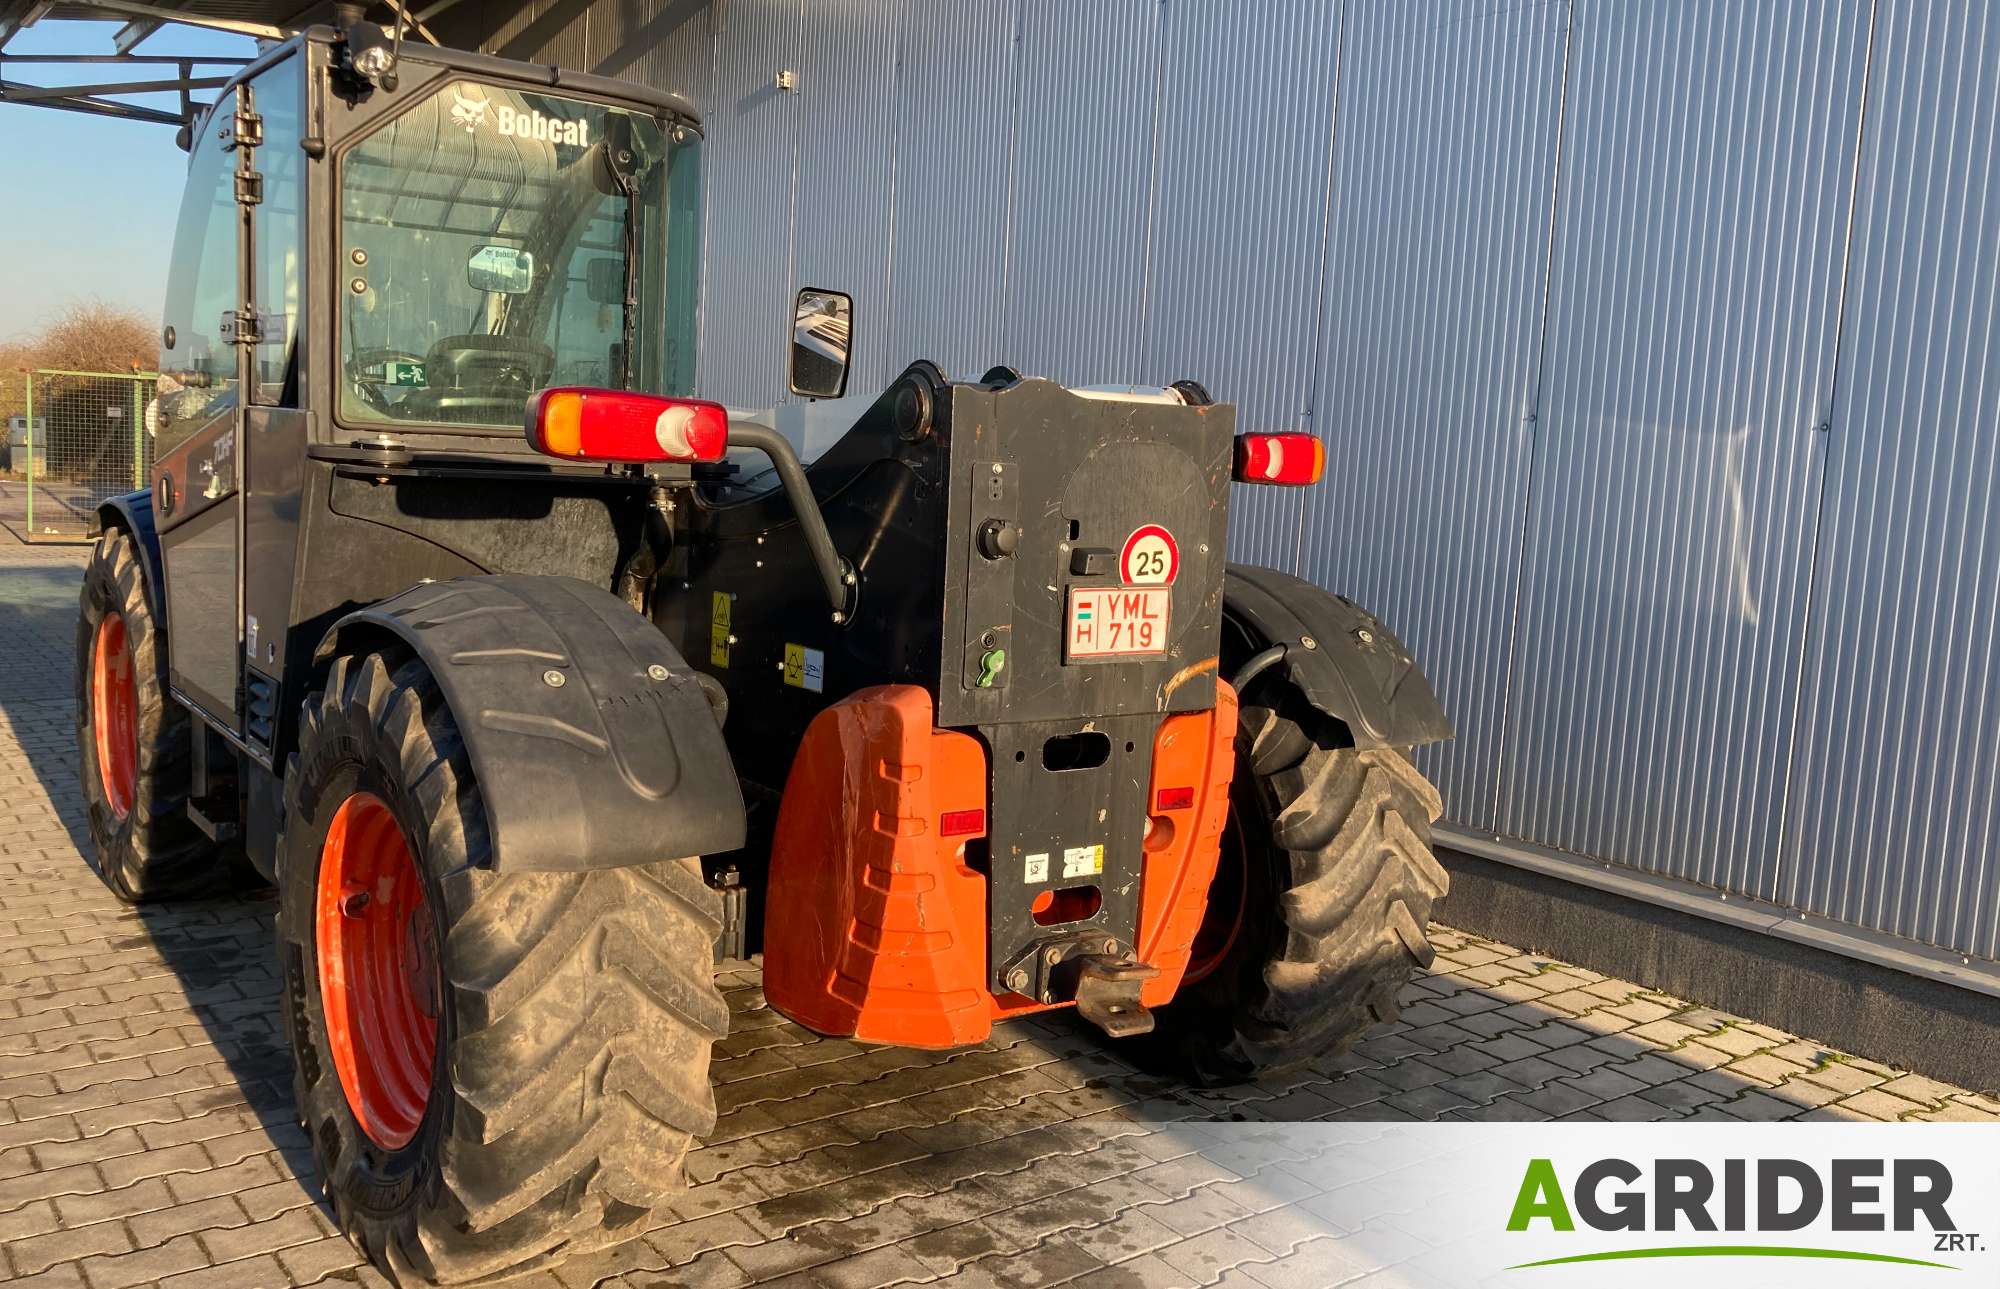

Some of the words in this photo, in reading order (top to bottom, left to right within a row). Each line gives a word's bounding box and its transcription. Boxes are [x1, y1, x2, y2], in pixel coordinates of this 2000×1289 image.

[498, 105, 588, 147] Bobcat
[1135, 550, 1164, 577] 25
[1107, 593, 1158, 620] YML
[1076, 623, 1092, 644] H
[1109, 621, 1153, 650] 719
